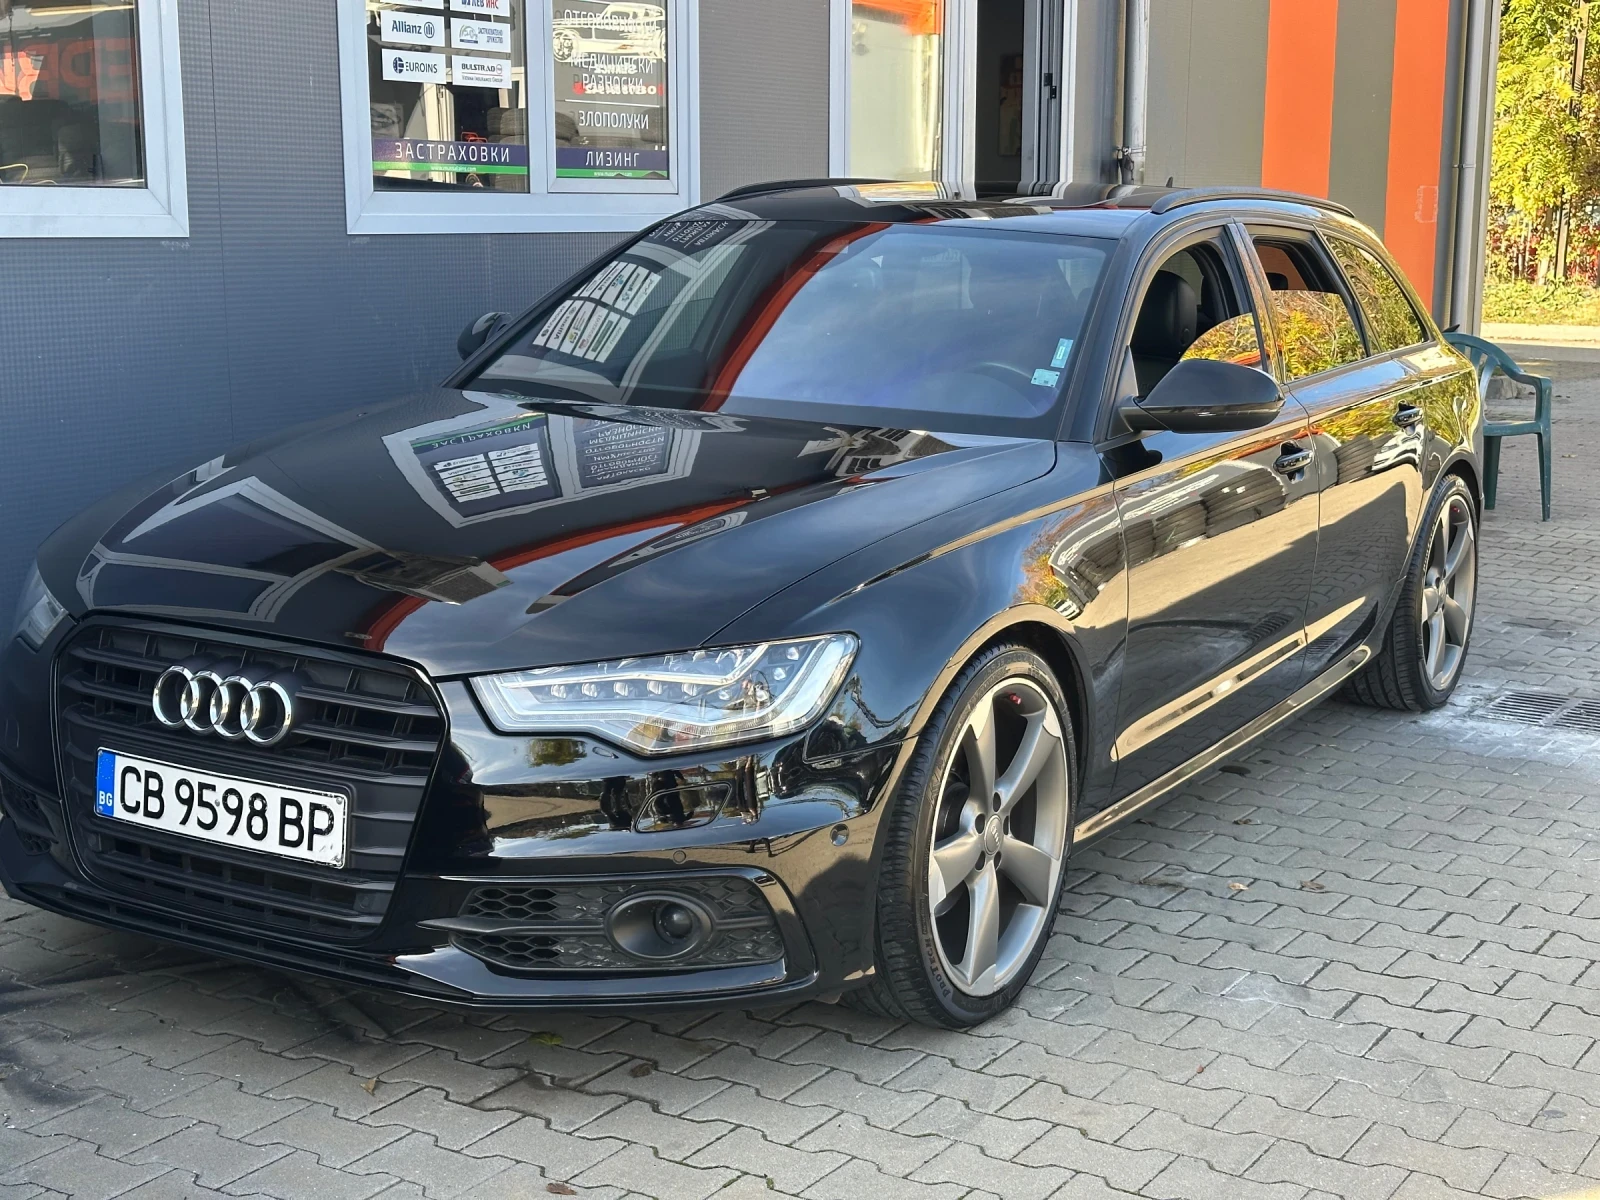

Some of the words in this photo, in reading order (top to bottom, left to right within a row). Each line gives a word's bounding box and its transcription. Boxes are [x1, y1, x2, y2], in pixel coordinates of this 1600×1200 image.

[391, 20, 422, 35] Allianz
[405, 61, 438, 74] EUROINS
[461, 63, 496, 73] BULSTRAD
[571, 53, 653, 74] МЕДИЦИНСКИ
[582, 74, 643, 90] РАЗНОСКИ
[578, 110, 649, 129] ЗЛОПОЛУКИ
[395, 142, 510, 162] ЗАСТРАХОВКИ
[585, 151, 640, 167] ЛИЗИНГ
[98, 791, 113, 807] BG
[120, 765, 165, 820] CB
[174, 778, 269, 841] 9598
[278, 797, 335, 851] BP
